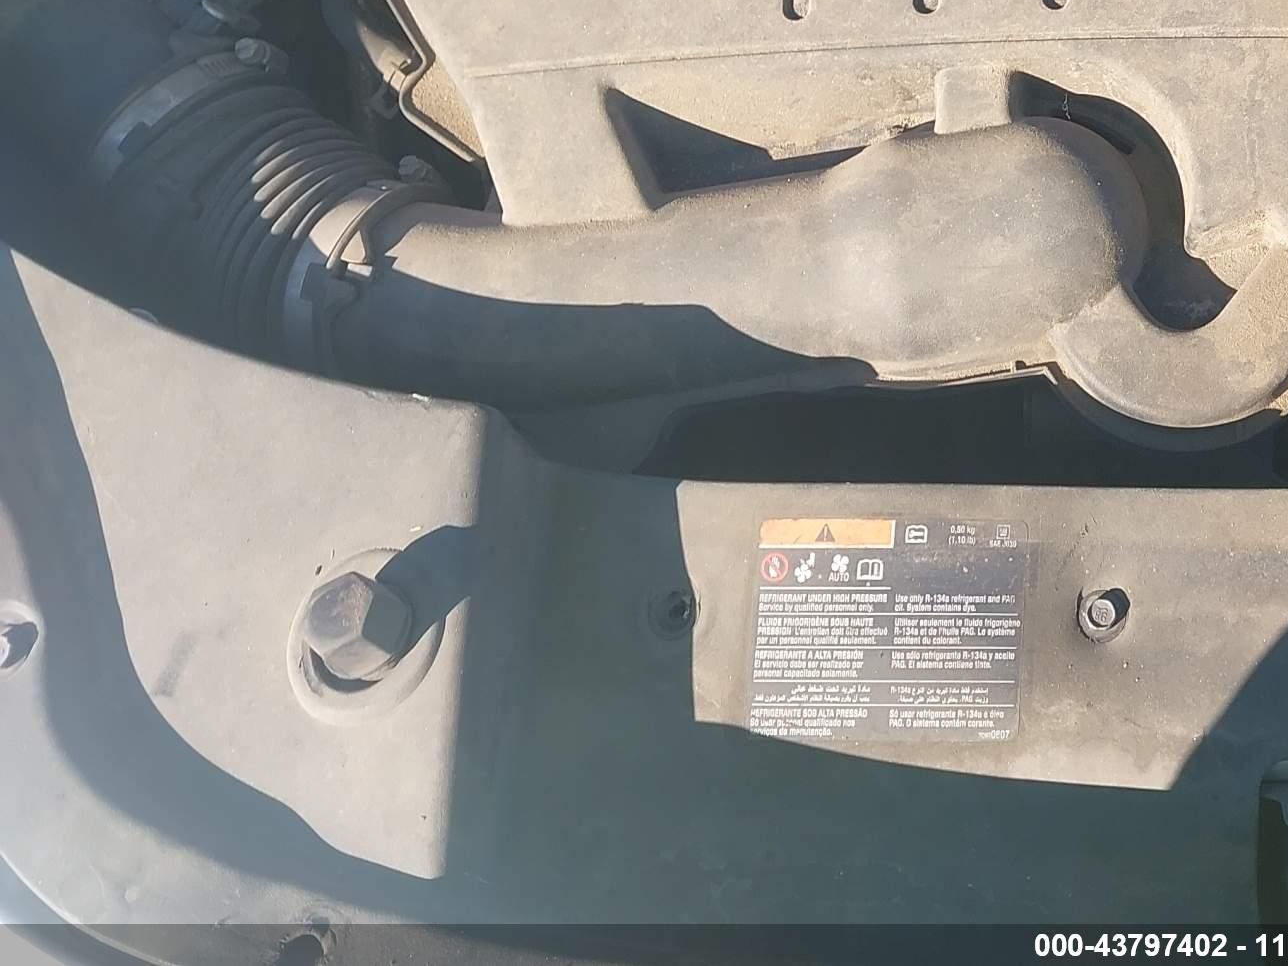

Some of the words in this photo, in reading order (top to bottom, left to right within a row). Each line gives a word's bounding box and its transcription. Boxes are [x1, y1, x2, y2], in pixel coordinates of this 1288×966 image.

[966, 525, 976, 536] kg
[828, 572, 850, 582] AUTO
[759, 593, 807, 603] REFRIGERANT
[807, 593, 832, 603] UNDER
[833, 593, 850, 603] HIGH
[851, 593, 888, 603] PRESSURE
[895, 593, 908, 603] Use
[909, 593, 924, 605] only
[925, 593, 950, 603] R-134a
[951, 593, 986, 604] refrigerant
[987, 593, 1000, 603] and
[759, 602, 784, 612] Service
[784, 602, 794, 613] by
[794, 602, 823, 613] qualified
[824, 603, 858, 613] personnel
[858, 602, 874, 613] only.
[906, 603, 931, 613] System
[933, 603, 962, 612] contains
[962, 603, 977, 614] dye.
[757, 617, 782, 627] FLUIDE
[830, 617, 849, 627] SOUS
[850, 617, 874, 627] HAUTE
[894, 617, 918, 627] Utiliser
[919, 617, 954, 627] seulement
[956, 617, 963, 627] le
[964, 617, 983, 627] fluide
[830, 626, 844, 636] doit
[894, 627, 919, 636] R-134a
[920, 627, 927, 636] et
[928, 627, 938, 636] de
[960, 627, 976, 636] PAG.
[977, 627, 986, 636] Le
[756, 637, 769, 646] par
[769, 636, 778, 645] un
[779, 636, 813, 646] personnel
[894, 636, 921, 645] contient
[922, 636, 932, 645] du
[754, 650, 806, 660] REFRIGERANTE
[814, 650, 832, 660] ALTA
[832, 648, 864, 660] PRESIÓN
[921, 650, 961, 661] refrigerante
[962, 650, 987, 660] R-134a
[754, 660, 760, 669] El
[762, 660, 788, 669] servicio
[789, 660, 806, 669] debe
[807, 660, 819, 669] ser
[820, 660, 851, 669] realizado
[851, 661, 864, 669] por
[908, 660, 916, 669] El
[916, 660, 943, 669] sistema
[944, 660, 974, 669] contiene
[753, 669, 782, 679] personal
[783, 669, 820, 679] capacitado
[802, 708, 817, 718] SOB
[818, 708, 834, 718] ALTA
[889, 709, 898, 719] Só
[899, 709, 914, 719] usar
[916, 709, 956, 720] refrigerante
[957, 709, 982, 719] R-134a
[804, 718, 842, 728] qualificado
[842, 718, 856, 727] nos
[912, 719, 940, 727] sistema
[778, 728, 788, 736] de
